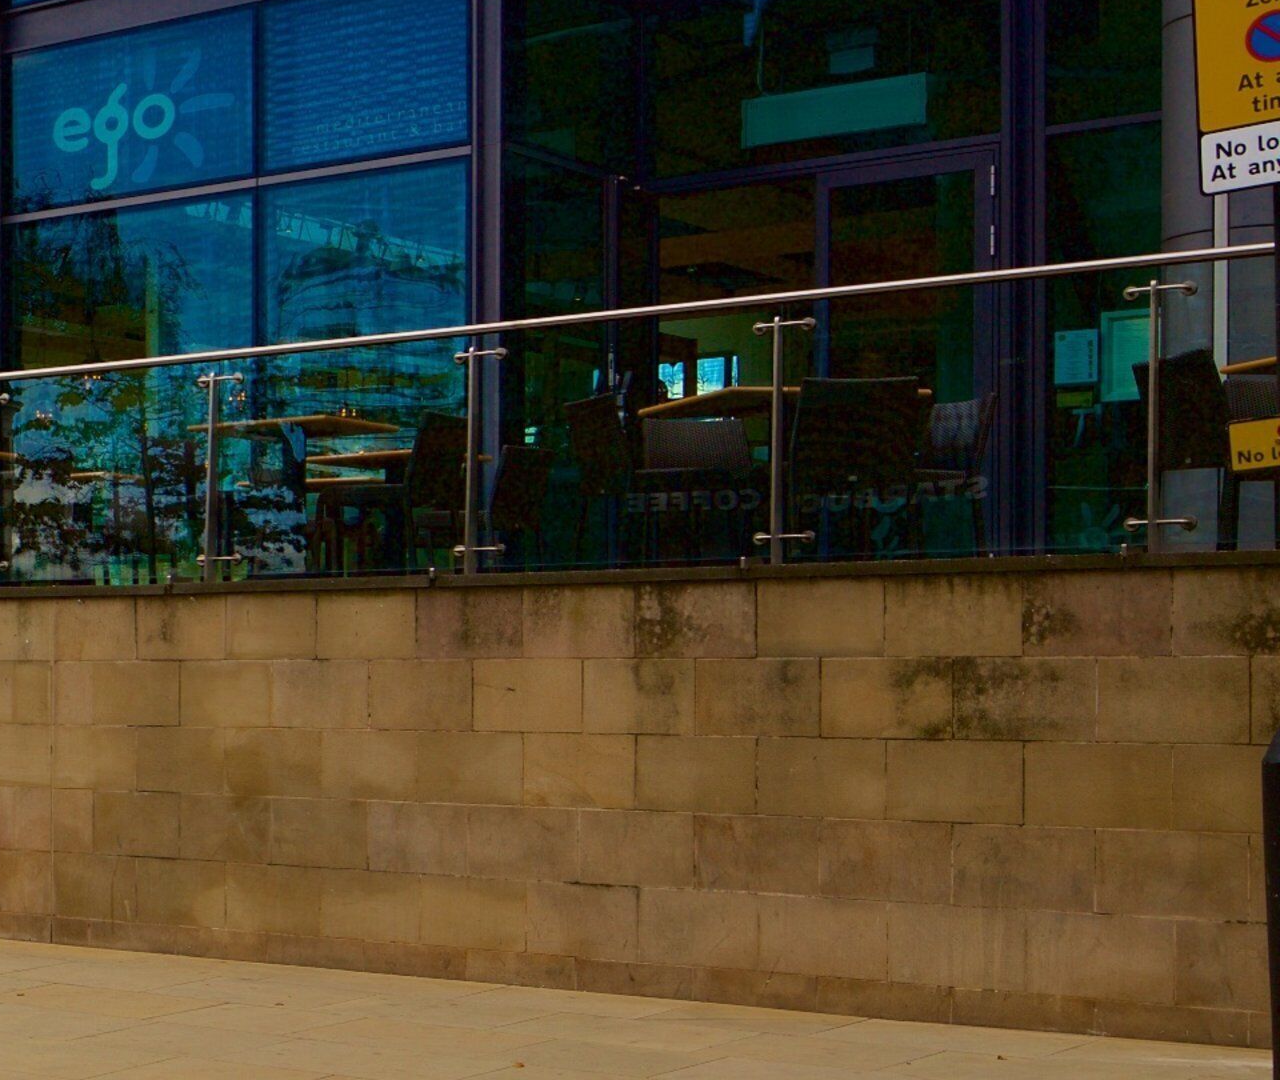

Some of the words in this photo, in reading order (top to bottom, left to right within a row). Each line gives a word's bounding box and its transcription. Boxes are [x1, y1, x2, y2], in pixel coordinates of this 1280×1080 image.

[1238, 72, 1264, 91] At
[53, 82, 175, 190] ego
[1216, 140, 1247, 159] No
[1211, 162, 1237, 182] At
[1237, 450, 1264, 465] No
